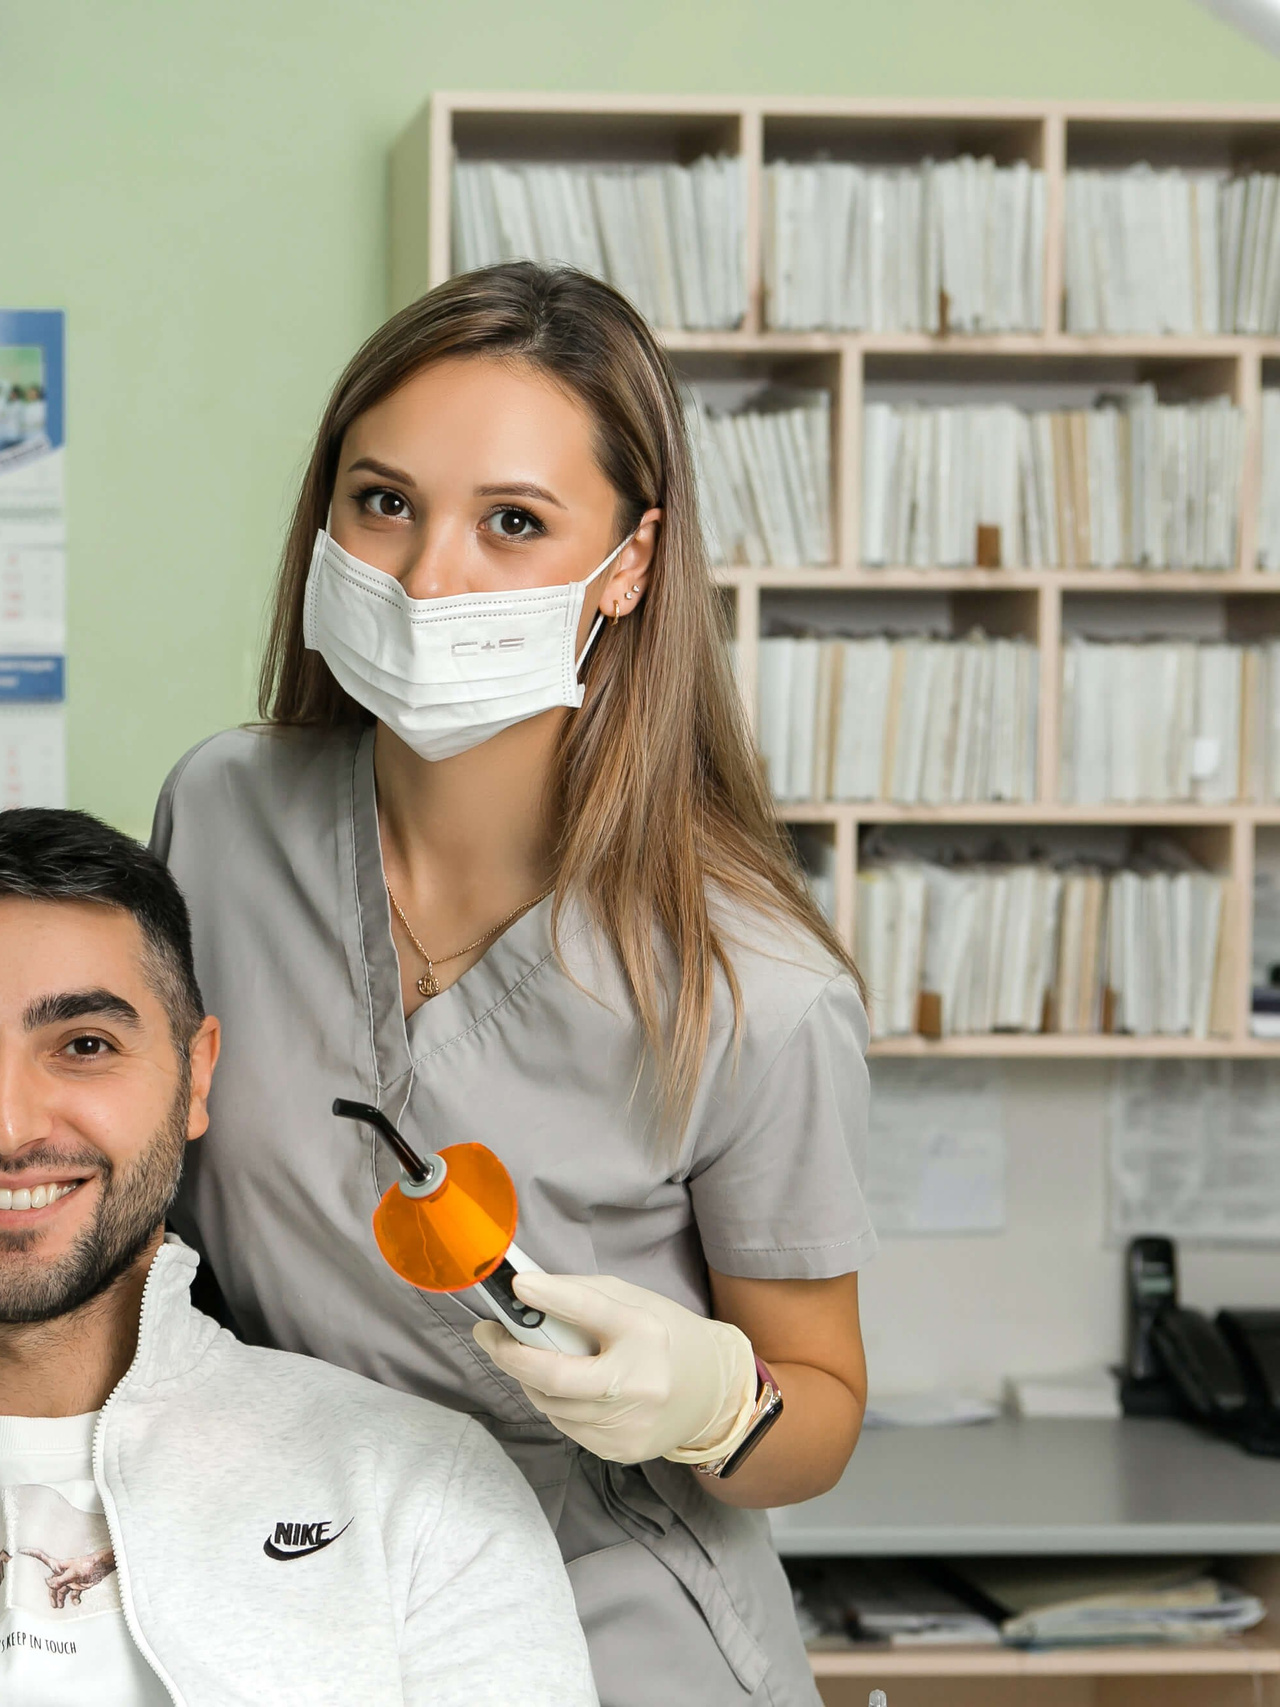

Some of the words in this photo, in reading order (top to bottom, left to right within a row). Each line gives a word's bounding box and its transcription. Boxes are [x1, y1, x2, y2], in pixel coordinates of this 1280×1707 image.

[274, 1521, 332, 1546] NIKE
[6, 1631, 27, 1649] KEEP
[29, 1634, 42, 1650] IN
[45, 1639, 77, 1655] TOUCH
